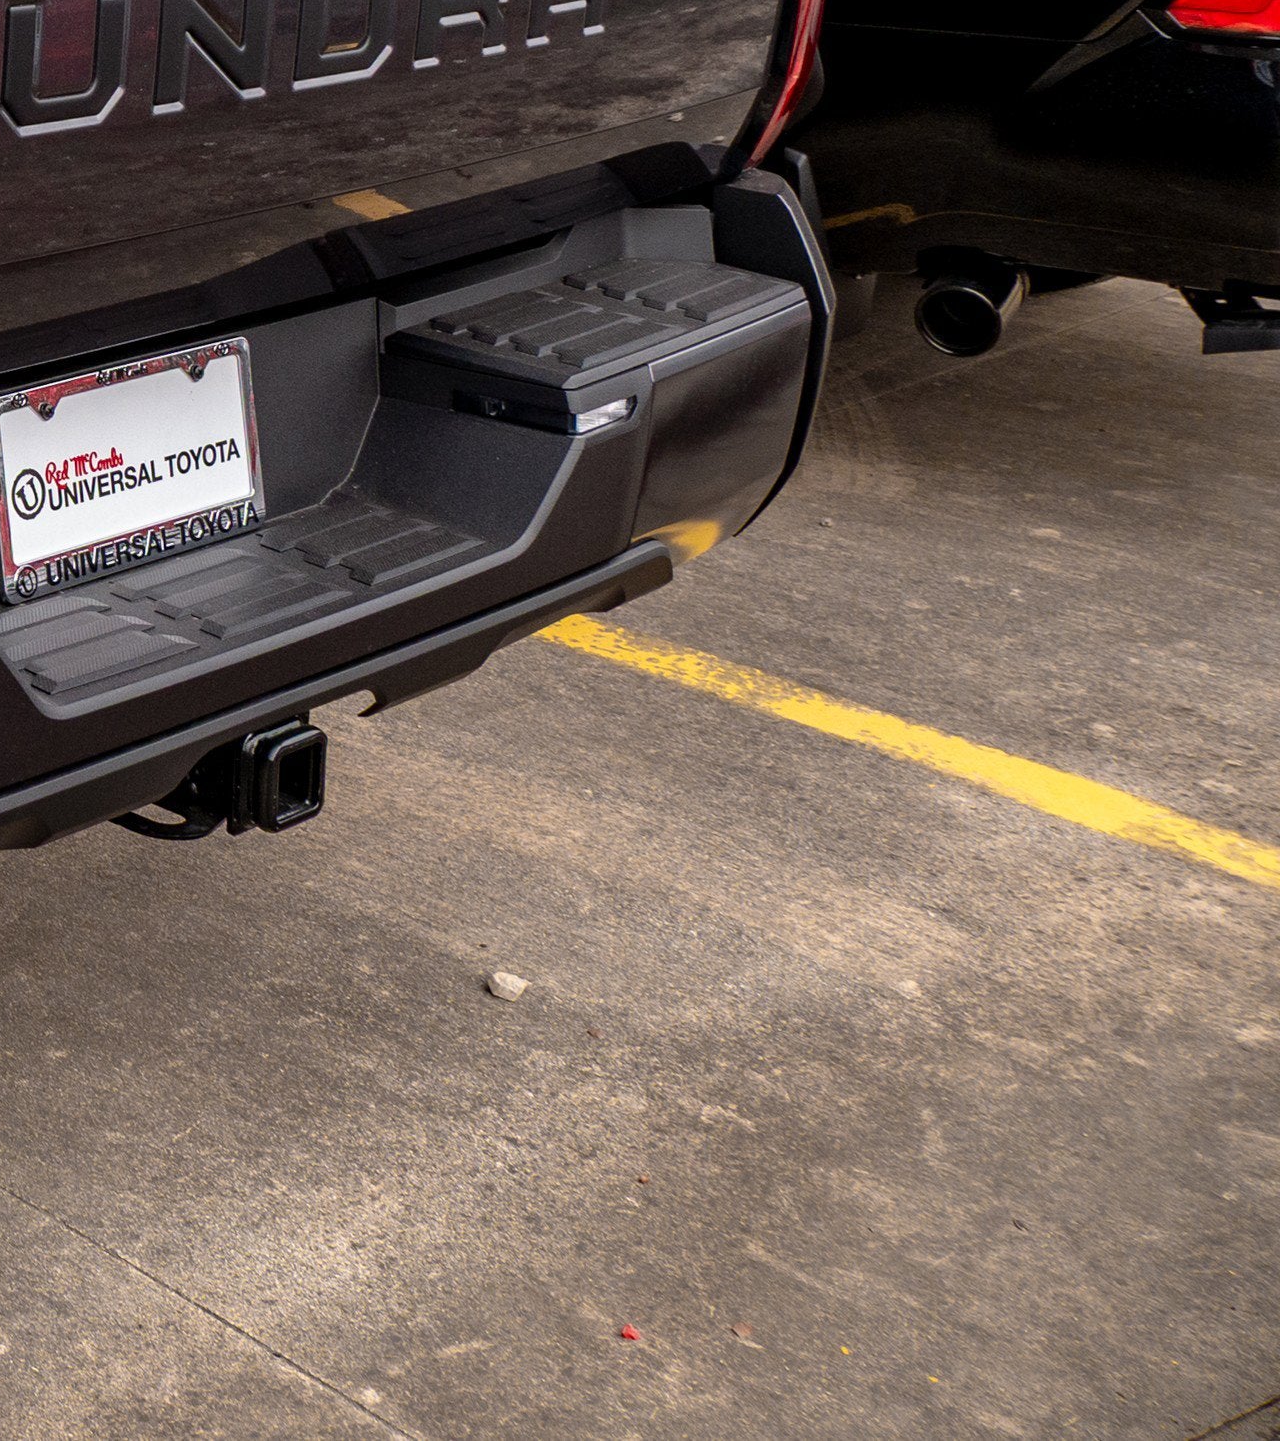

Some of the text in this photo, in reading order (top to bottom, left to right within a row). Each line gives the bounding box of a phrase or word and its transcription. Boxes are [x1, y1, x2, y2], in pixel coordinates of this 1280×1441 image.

[45, 460, 69, 489] Red
[47, 459, 162, 511] UNIVERSAL
[164, 438, 240, 478] TOYOTA
[45, 525, 175, 585] UNIVERSAL
[173, 500, 260, 546] TOYOTA
